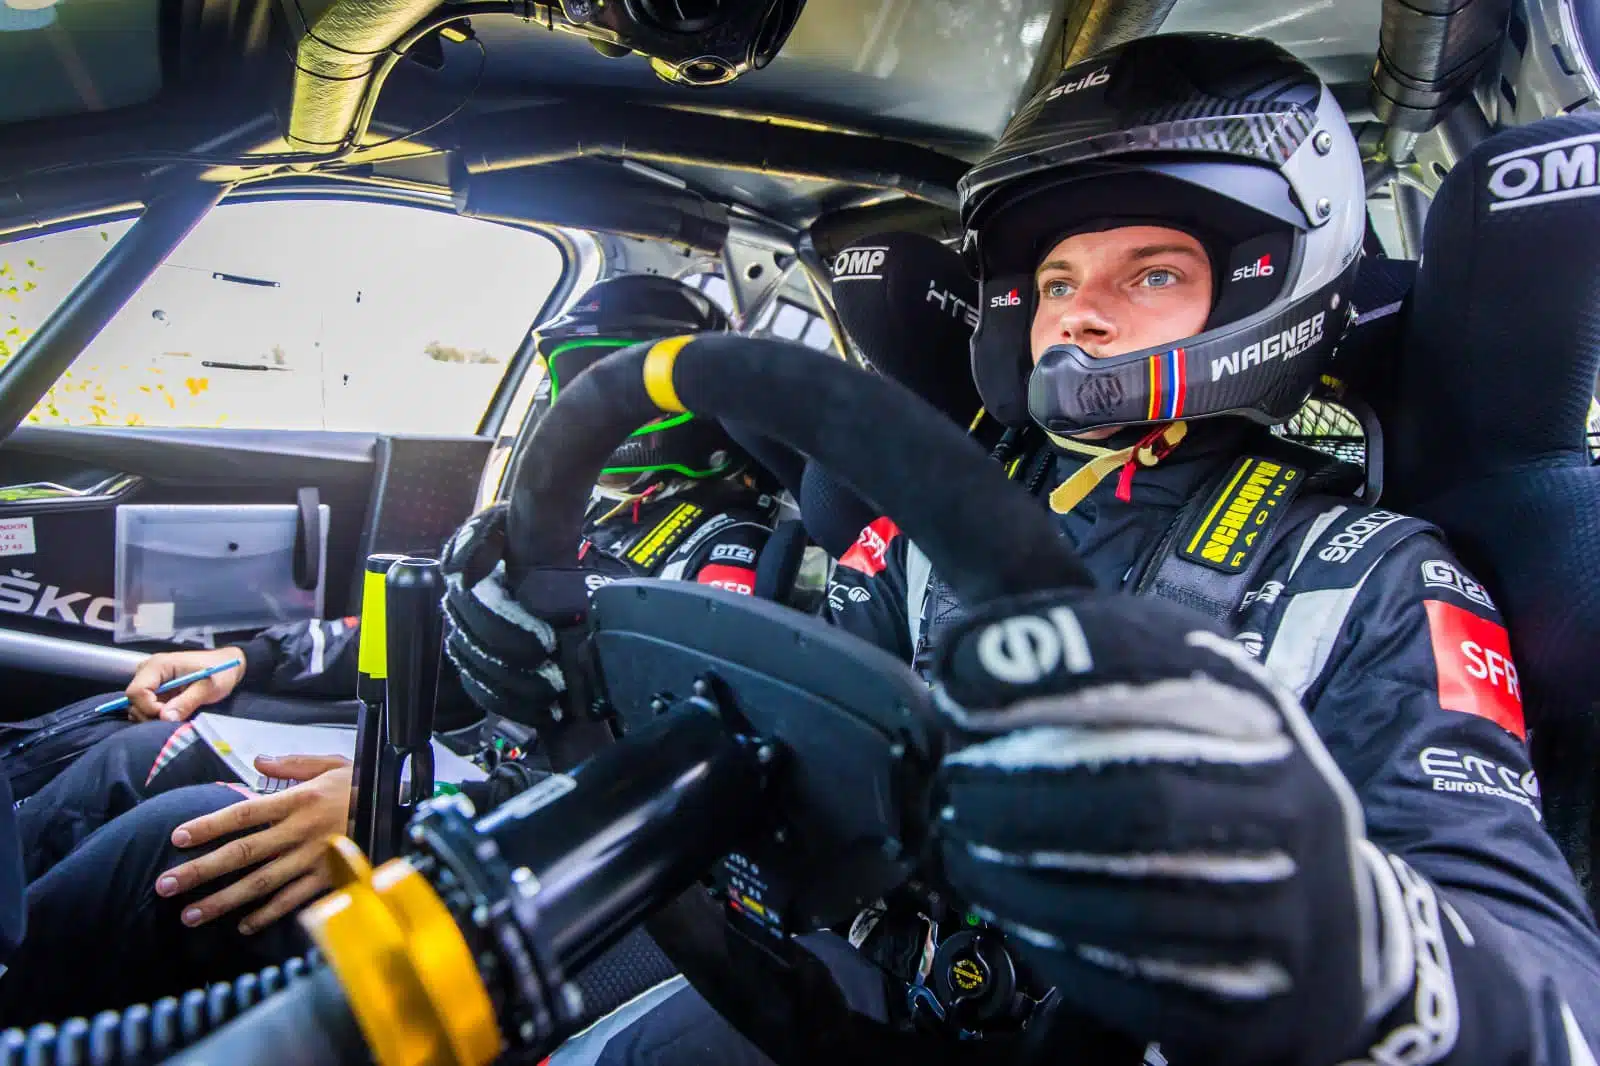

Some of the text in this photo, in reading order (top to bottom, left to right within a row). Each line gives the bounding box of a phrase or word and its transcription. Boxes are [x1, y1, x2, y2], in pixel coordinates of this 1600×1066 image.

[1488, 144, 1600, 199] OM
[834, 251, 886, 276] OMP
[1211, 311, 1325, 382] WAGNER
[1230, 470, 1296, 567] RACING
[1460, 640, 1521, 702] SFR
